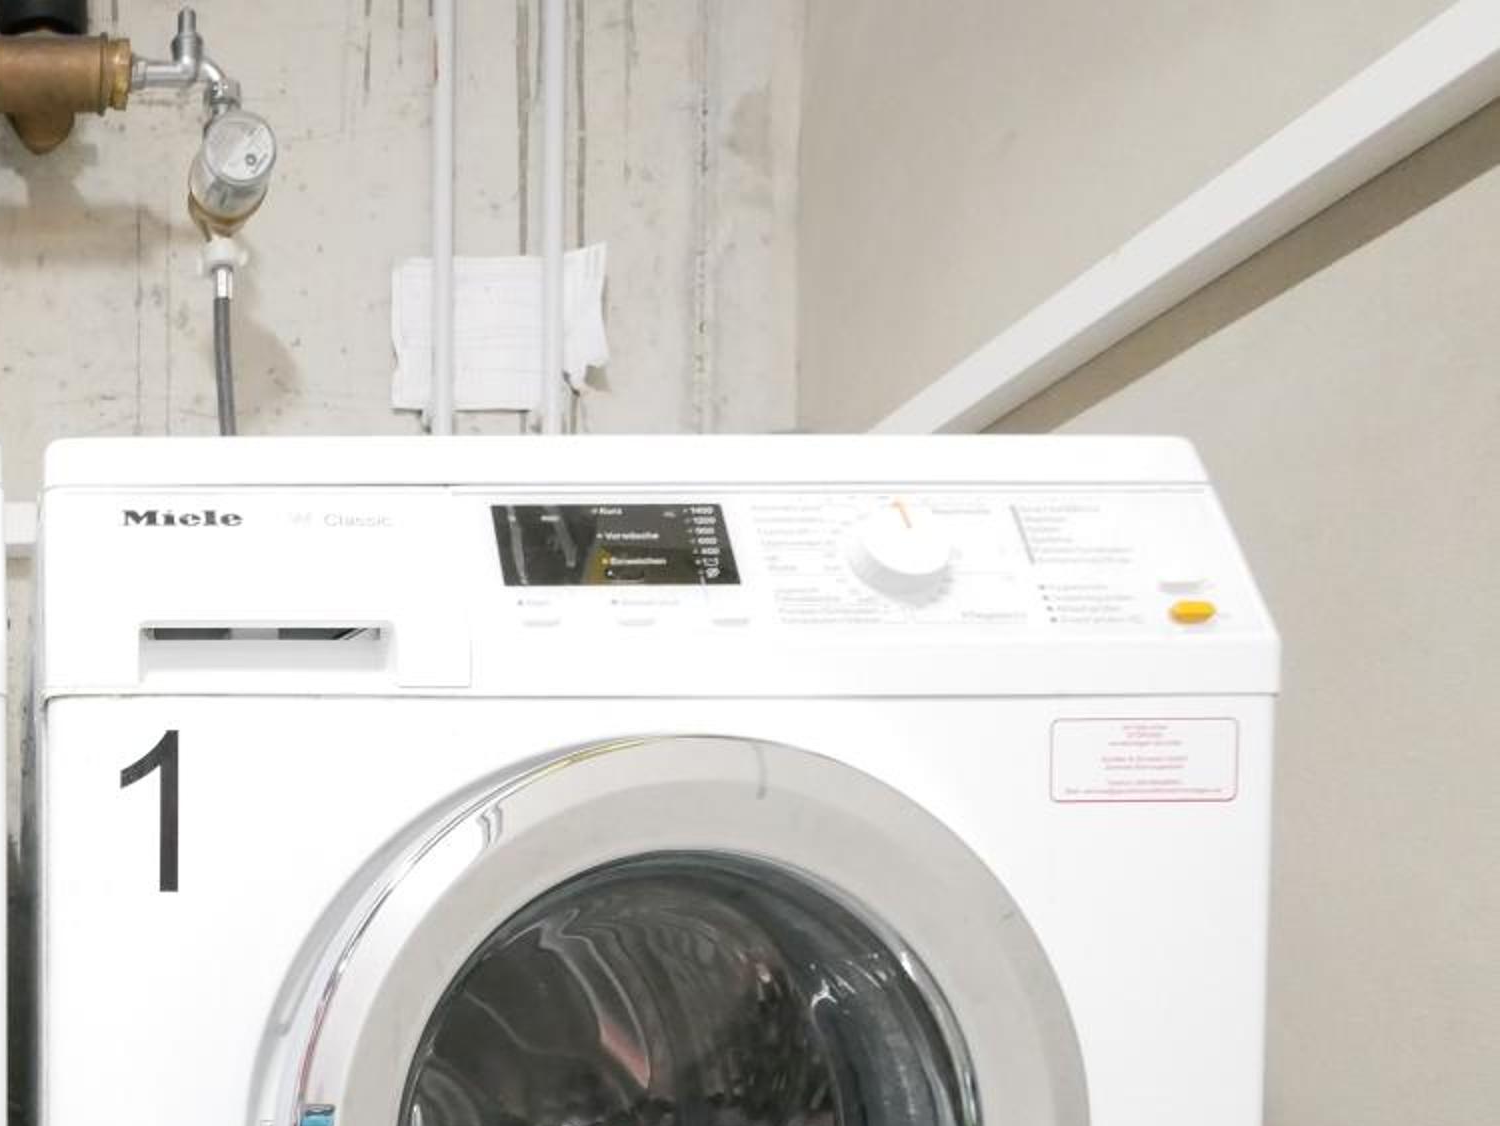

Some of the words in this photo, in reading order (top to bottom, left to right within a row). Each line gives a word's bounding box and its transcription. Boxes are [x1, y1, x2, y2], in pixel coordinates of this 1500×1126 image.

[123, 510, 243, 527] Miele
[323, 511, 391, 526] Classic
[120, 729, 179, 892] 1
